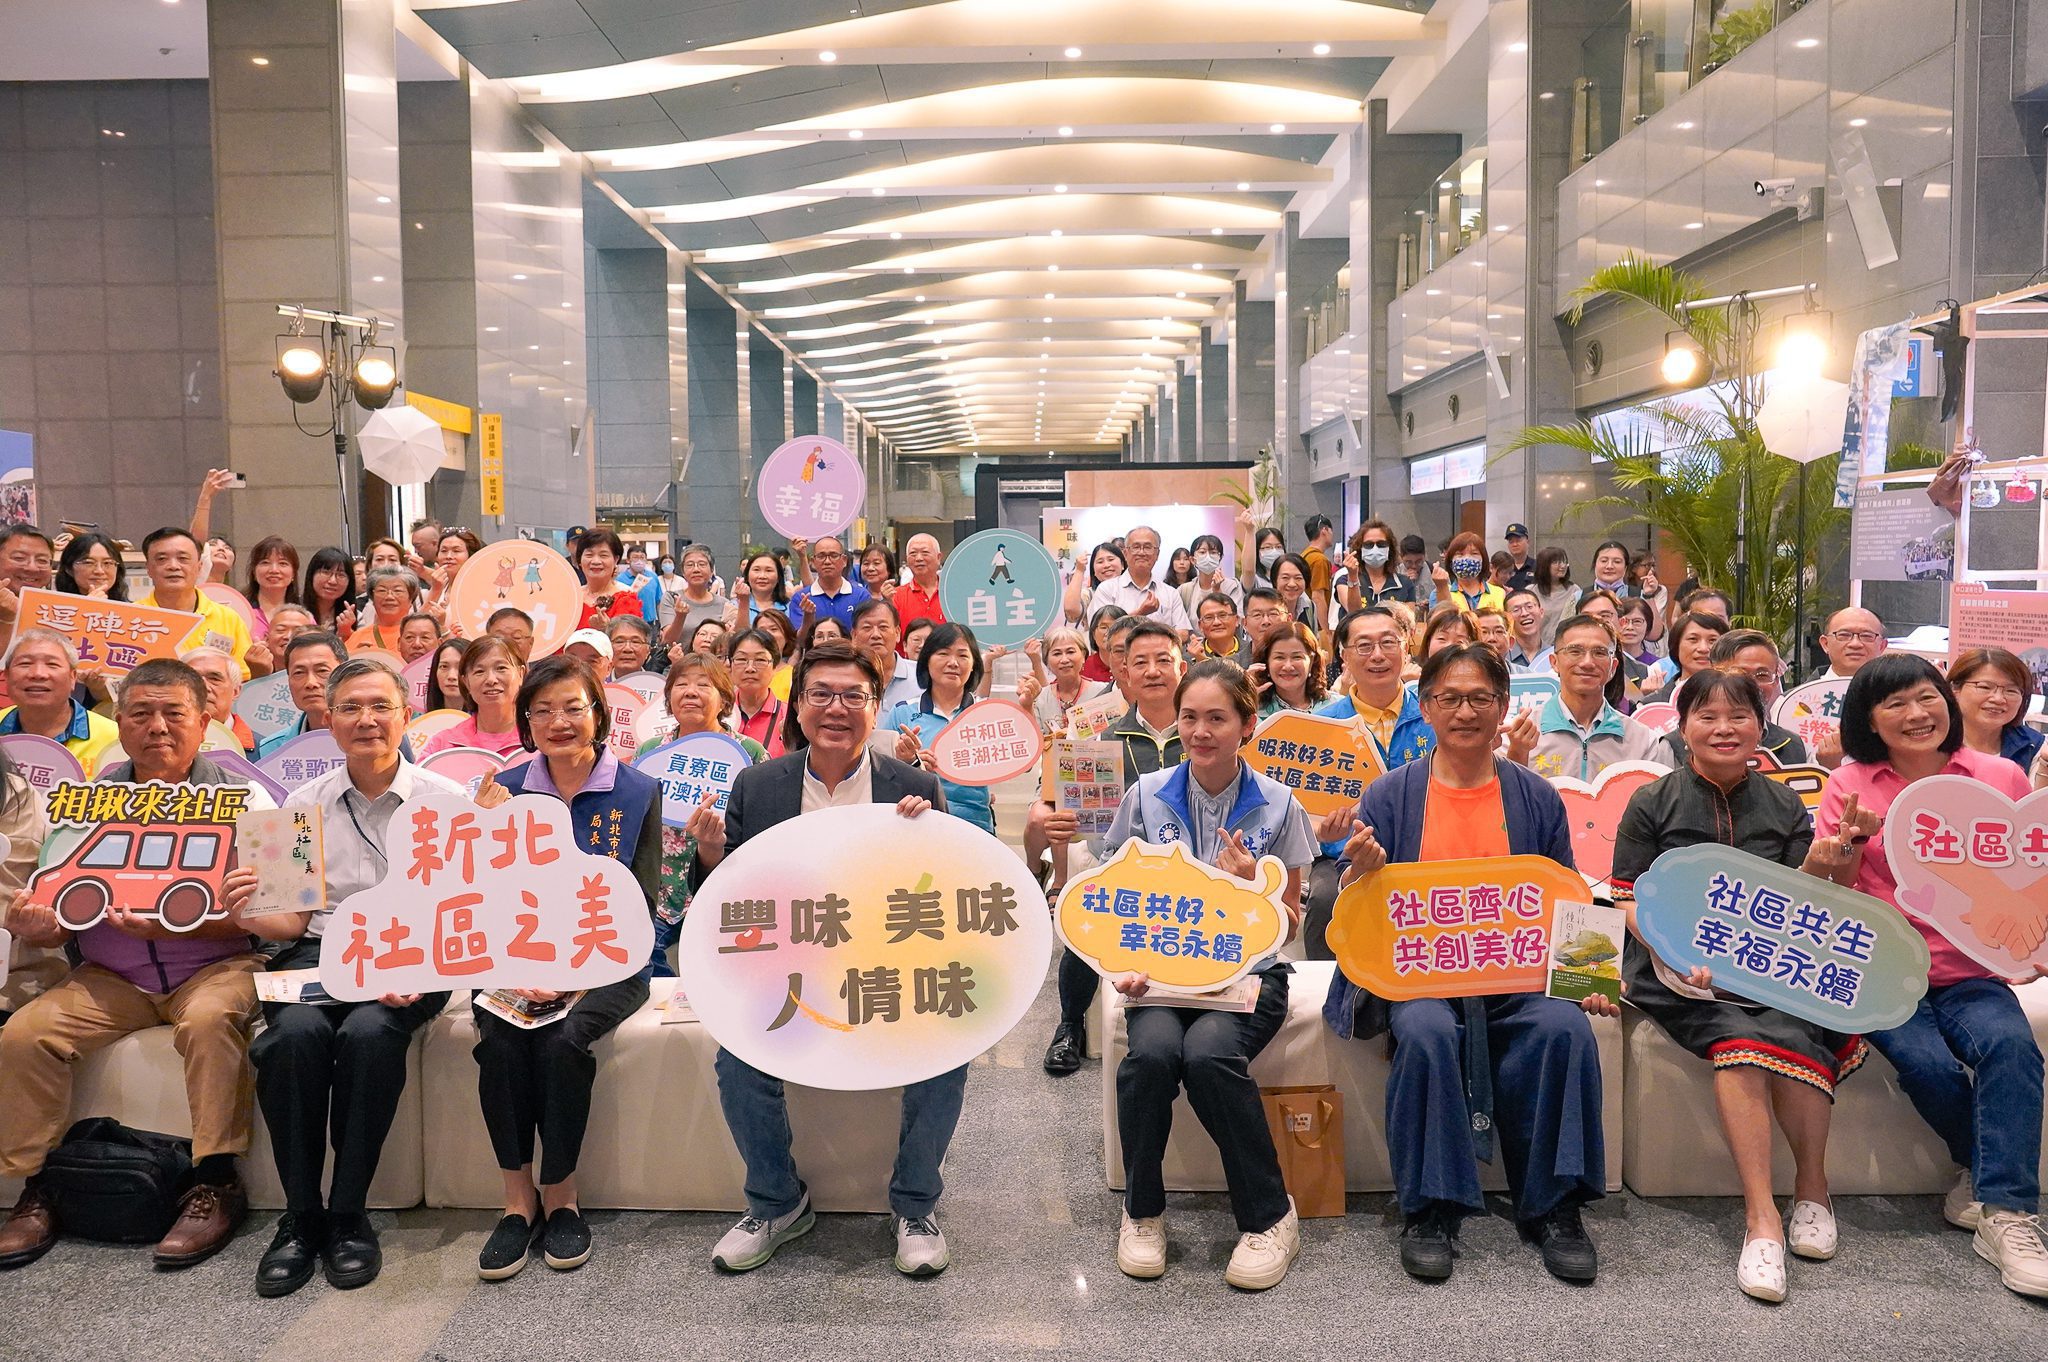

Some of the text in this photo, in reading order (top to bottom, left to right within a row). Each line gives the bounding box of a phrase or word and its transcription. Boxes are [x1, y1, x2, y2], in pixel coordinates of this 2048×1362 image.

[775, 485, 844, 524] 幸福
[36, 604, 170, 643] 逗陣行
[967, 589, 1037, 627] 自主
[254, 704, 302, 727] 忠寮
[959, 720, 1016, 743] 中和區
[667, 753, 731, 783] 貢寮區
[952, 740, 1029, 768] 碧湖社區
[1258, 739, 1369, 772] 服務好多元、
[1265, 766, 1363, 799] 社區金幸福
[48, 783, 250, 825] 相揪來社區
[293, 812, 315, 874] 新北社區之美
[407, 806, 560, 886] 新北
[717, 874, 1020, 954] 豐味 美味
[1082, 886, 1227, 926] 社區共好、
[1389, 885, 1542, 928] 社區齊心
[1705, 874, 1877, 961] 社區共生
[342, 873, 629, 988] 社區之美
[1119, 922, 1243, 965] 幸福永續
[1395, 929, 1547, 973] 共創美好
[1695, 918, 1863, 1007] 幸福永續
[766, 961, 978, 1033] 人情味
